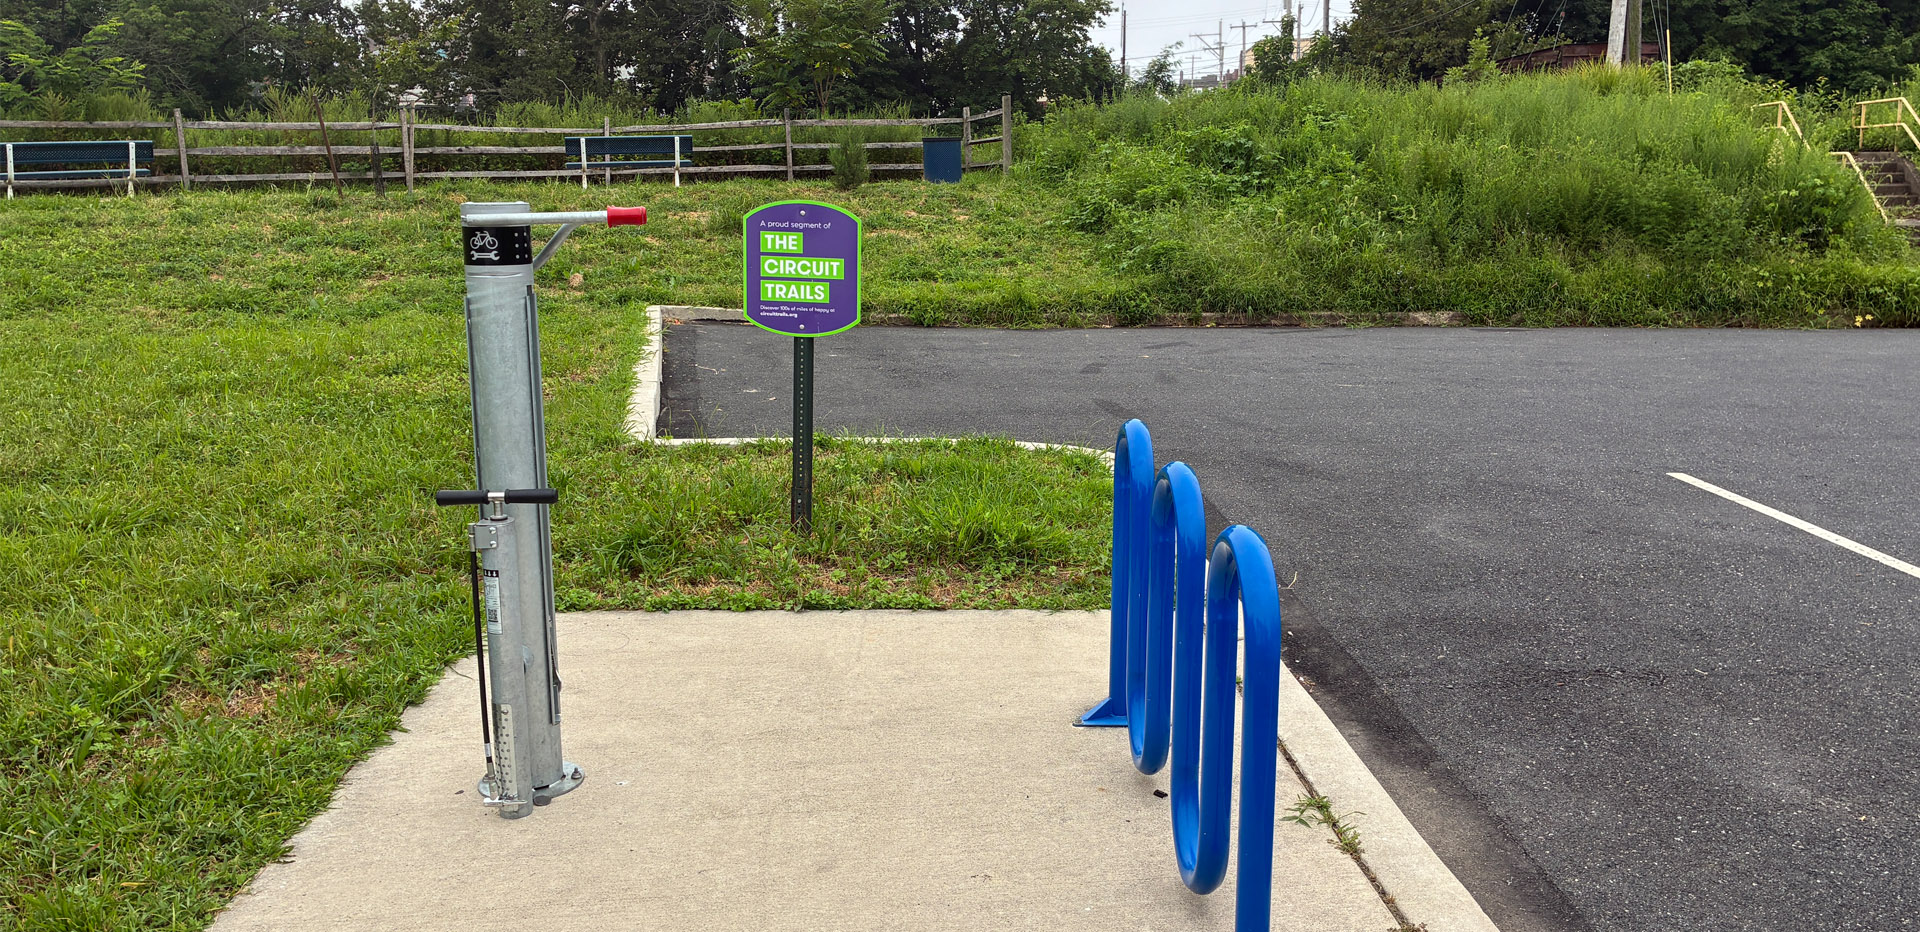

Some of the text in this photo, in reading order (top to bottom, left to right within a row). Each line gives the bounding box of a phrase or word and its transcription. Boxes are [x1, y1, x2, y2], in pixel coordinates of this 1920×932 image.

[767, 221, 789, 229] proud
[790, 222, 822, 230] segment
[764, 234, 798, 250] THE
[764, 259, 840, 276] CIRCUIT
[764, 283, 825, 300] TRAILS
